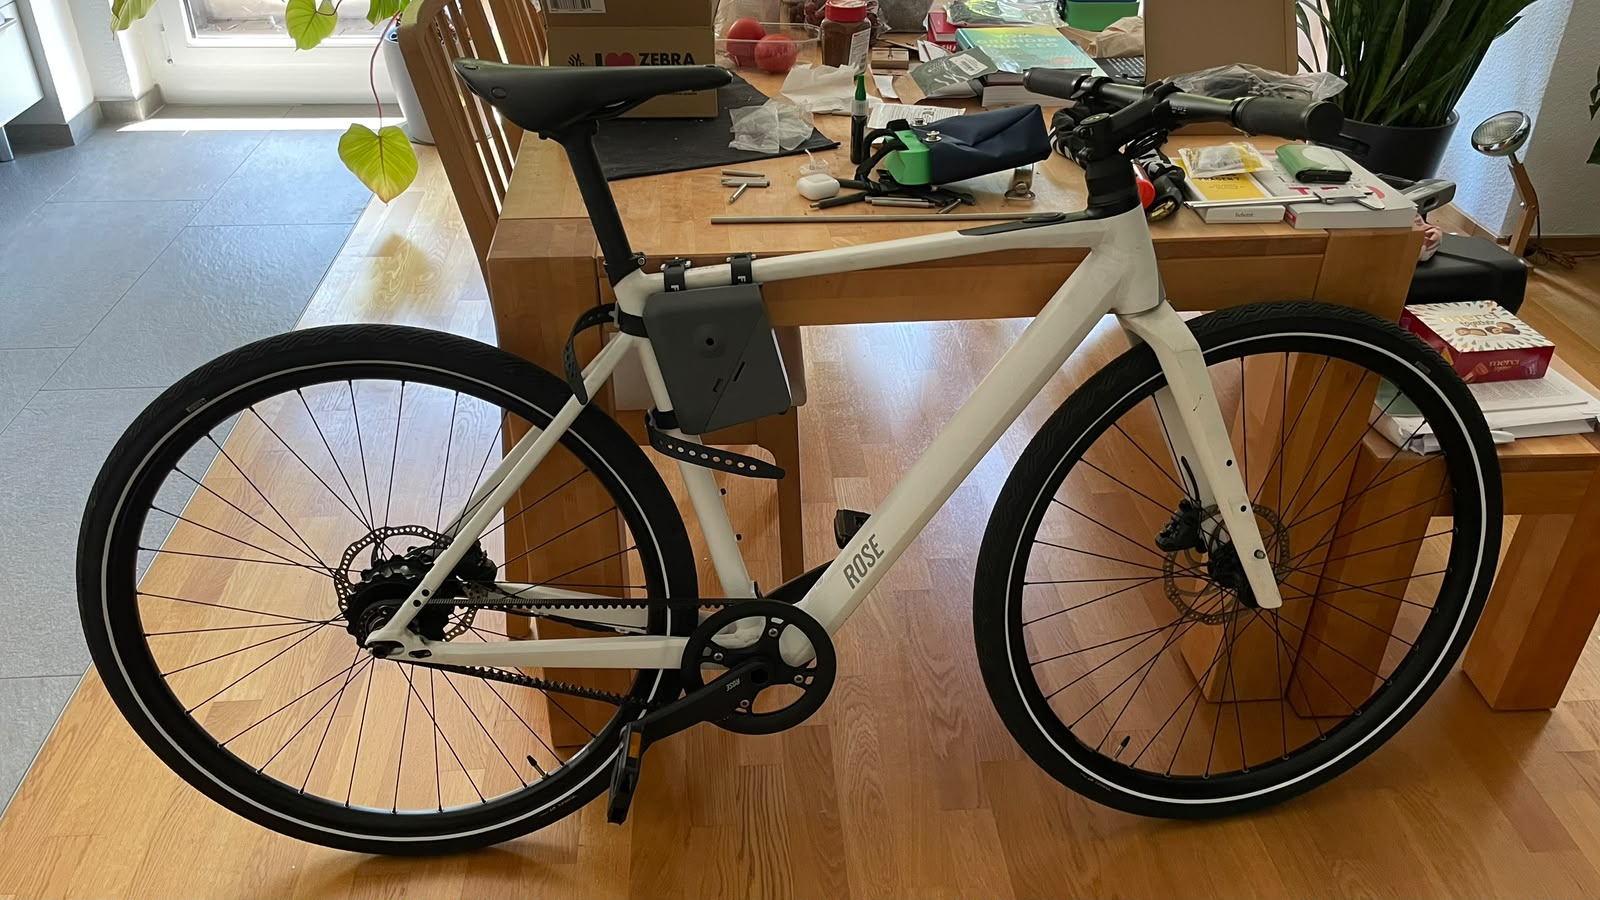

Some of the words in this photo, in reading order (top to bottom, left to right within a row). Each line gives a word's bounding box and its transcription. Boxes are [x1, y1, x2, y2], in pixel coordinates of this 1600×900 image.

[595, 53, 602, 66] I
[639, 53, 696, 66] ZEBRA
[1489, 359, 1520, 367] merci
[843, 533, 885, 590] ROSE
